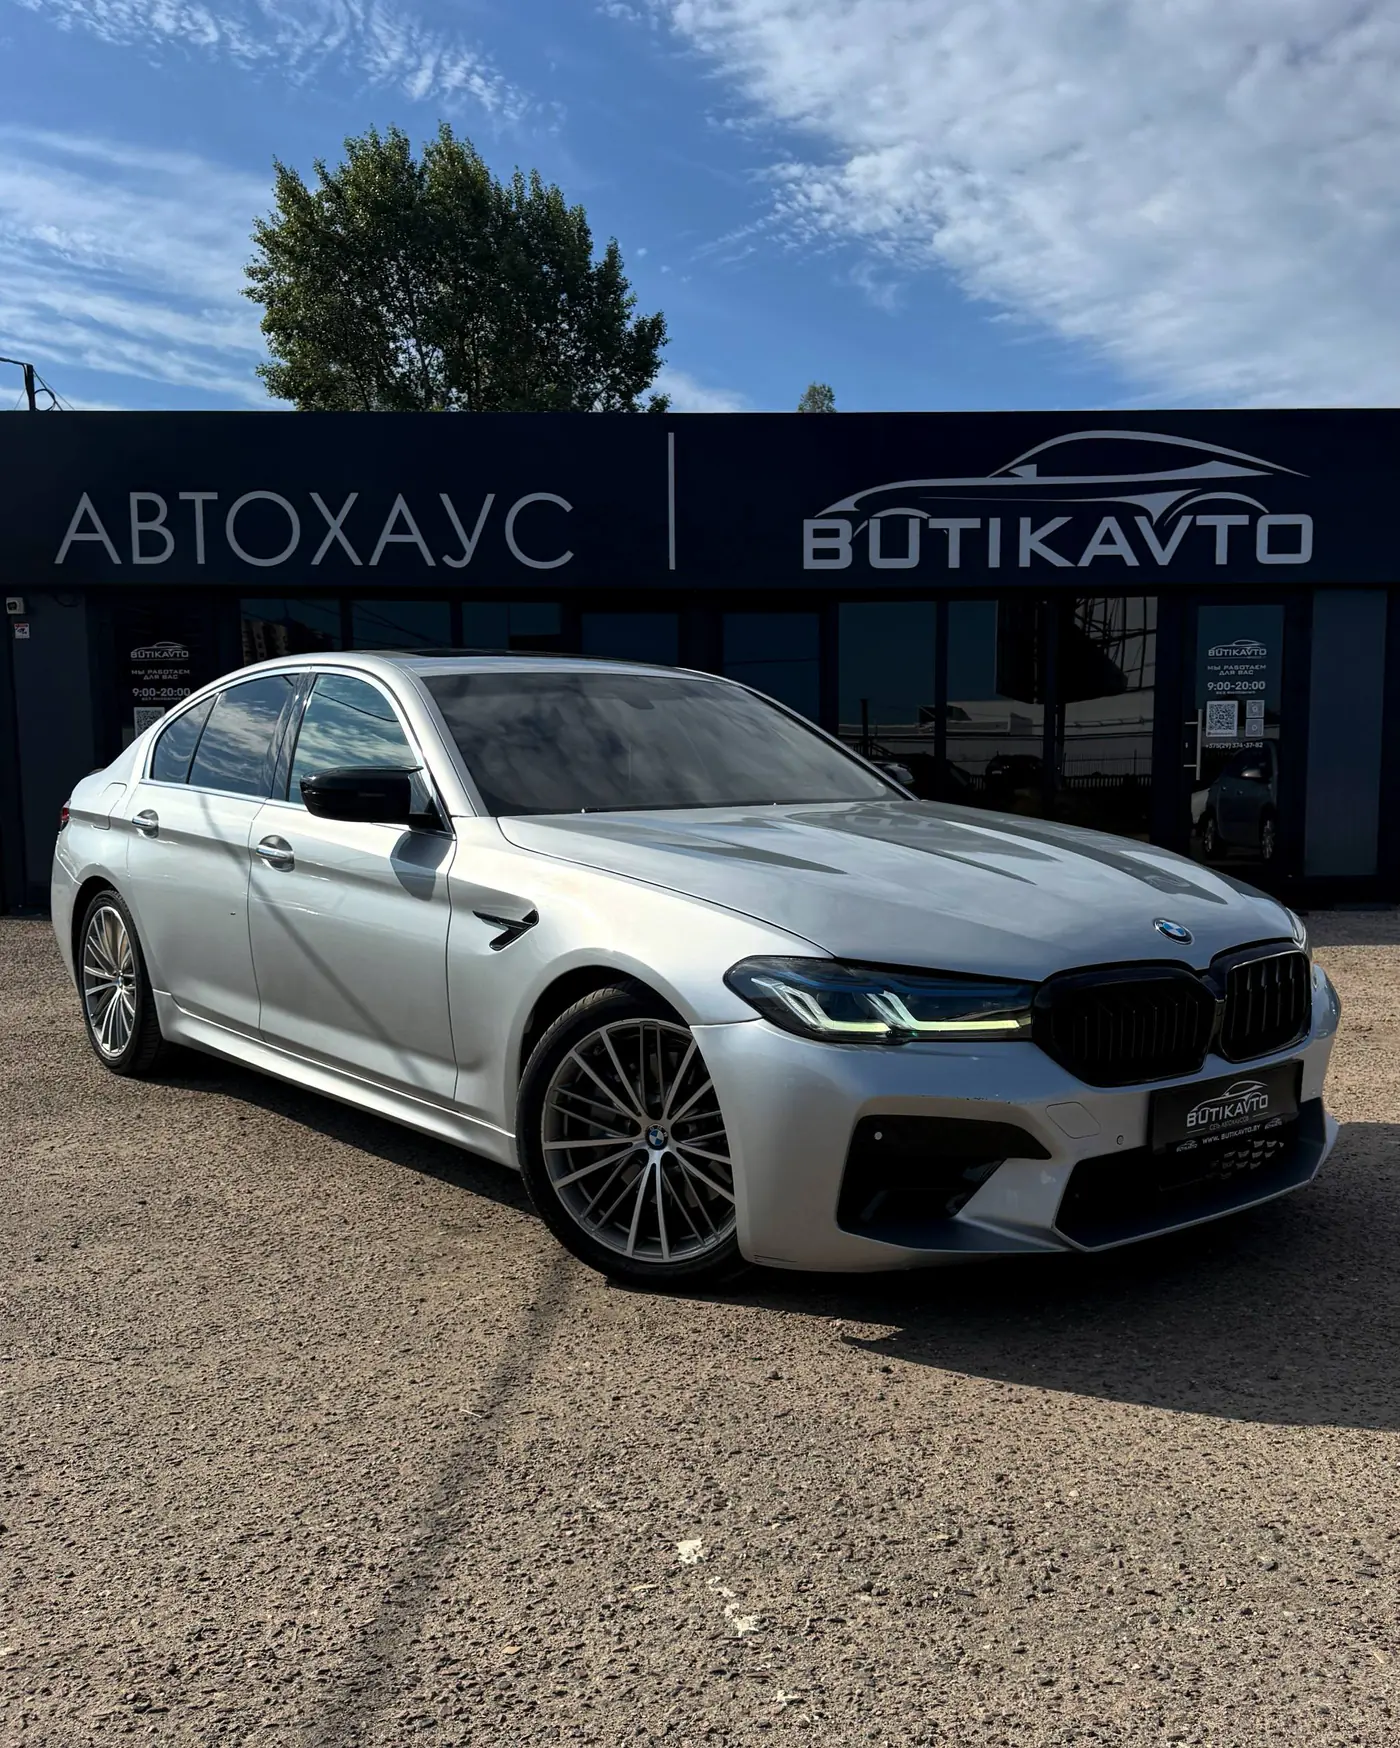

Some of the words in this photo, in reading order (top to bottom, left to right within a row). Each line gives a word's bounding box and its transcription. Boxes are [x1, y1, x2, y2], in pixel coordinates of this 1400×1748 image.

[55, 490, 575, 569] АВТОХАУС
[803, 513, 1314, 570] BUTIKAVTO
[130, 650, 189, 658] BUTIKAVTO
[1208, 648, 1267, 656] BUTIKAVTO
[1207, 681, 1266, 691] 9:00-20:00
[132, 687, 191, 697] 9:00-20:00
[1186, 1094, 1269, 1127] BUTIKAVTO
